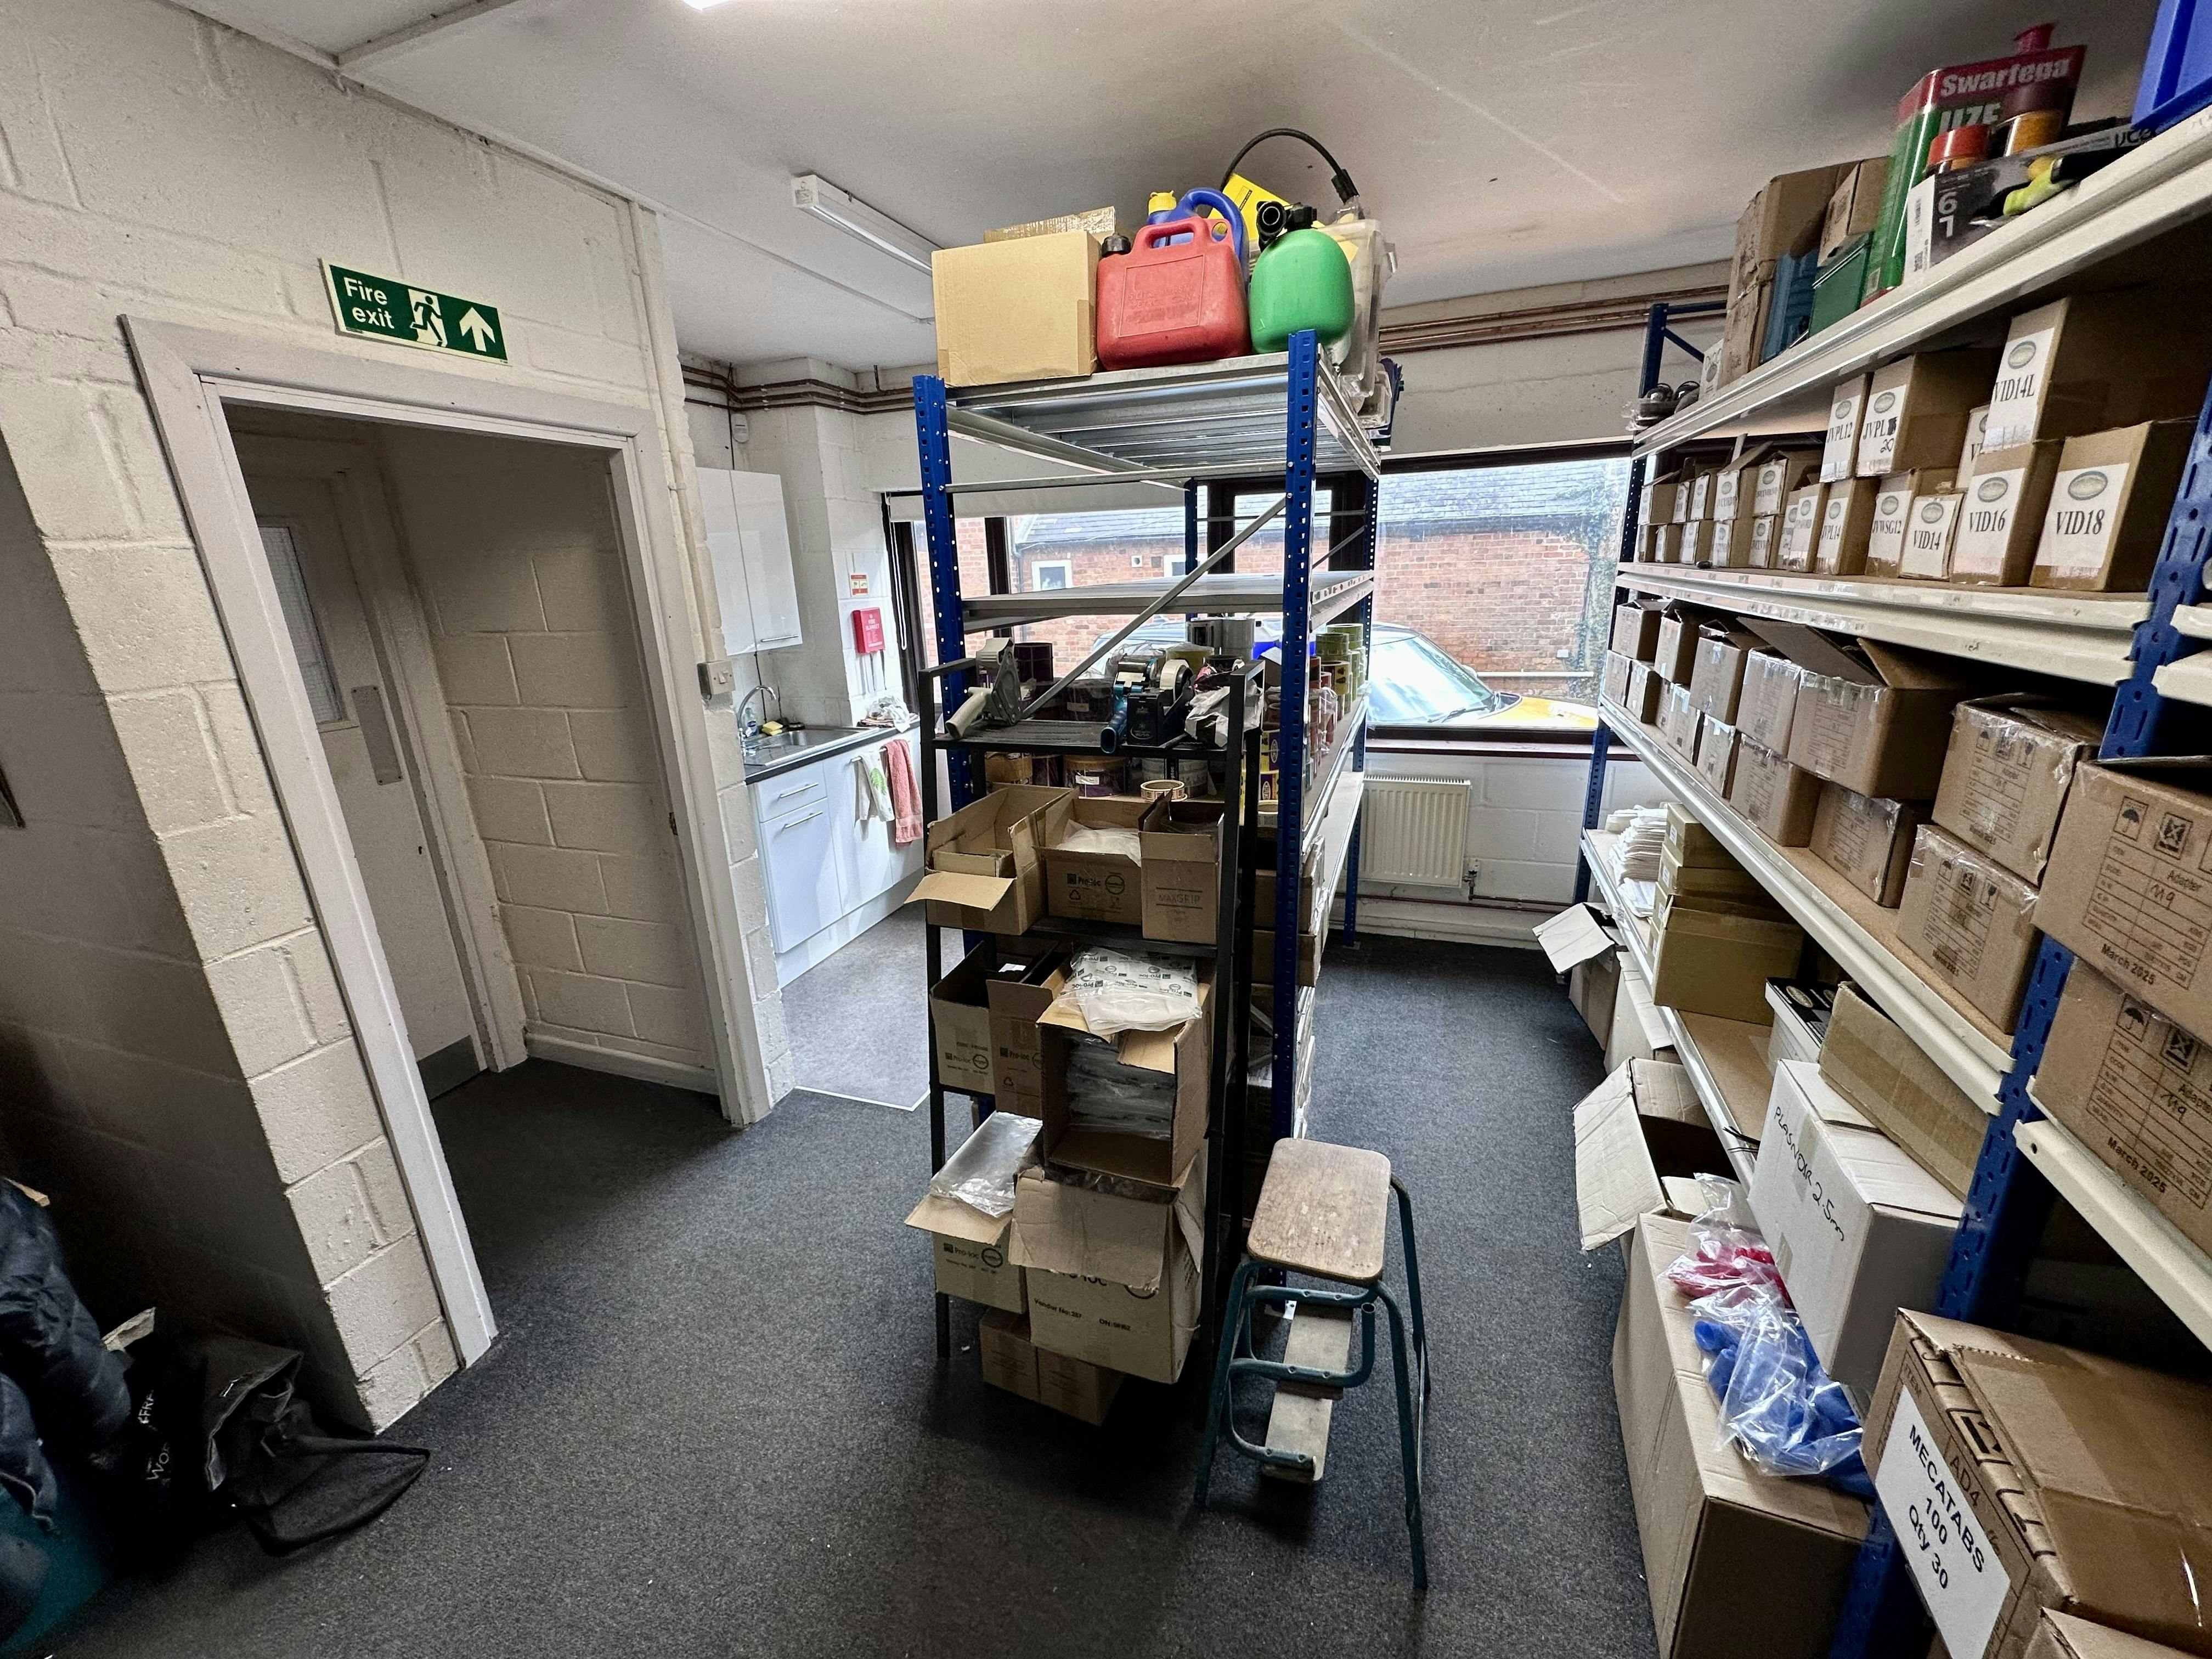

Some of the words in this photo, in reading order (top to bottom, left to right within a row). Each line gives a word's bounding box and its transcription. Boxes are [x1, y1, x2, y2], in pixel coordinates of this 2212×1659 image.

[1940, 58, 2070, 97] Swarfega
[1938, 192, 1957, 215] 6
[343, 276, 387, 305] Fire
[352, 307, 394, 329] exit
[1994, 374, 2036, 402] VID14L
[1827, 421, 1853, 443] JVPL12
[1863, 417, 1897, 439] JVPL
[1880, 438, 1894, 453] 20
[1821, 525, 1842, 540] JVPL14
[1970, 509, 2008, 532] VID16
[2057, 509, 2105, 535] VID18
[1914, 531, 1942, 550] VID14
[2101, 943, 2130, 971] March
[2130, 963, 2157, 986] 2025
[2107, 1136, 2139, 1171] March
[2139, 1165, 2168, 1194] 2025
[1034, 1298, 1057, 1312] Vendor
[1910, 1425, 1984, 1573] MECATABS
[1926, 1498, 1948, 1545] 100
[1910, 1504, 1930, 1551] Qty
[1932, 1554, 1948, 1589] 30
